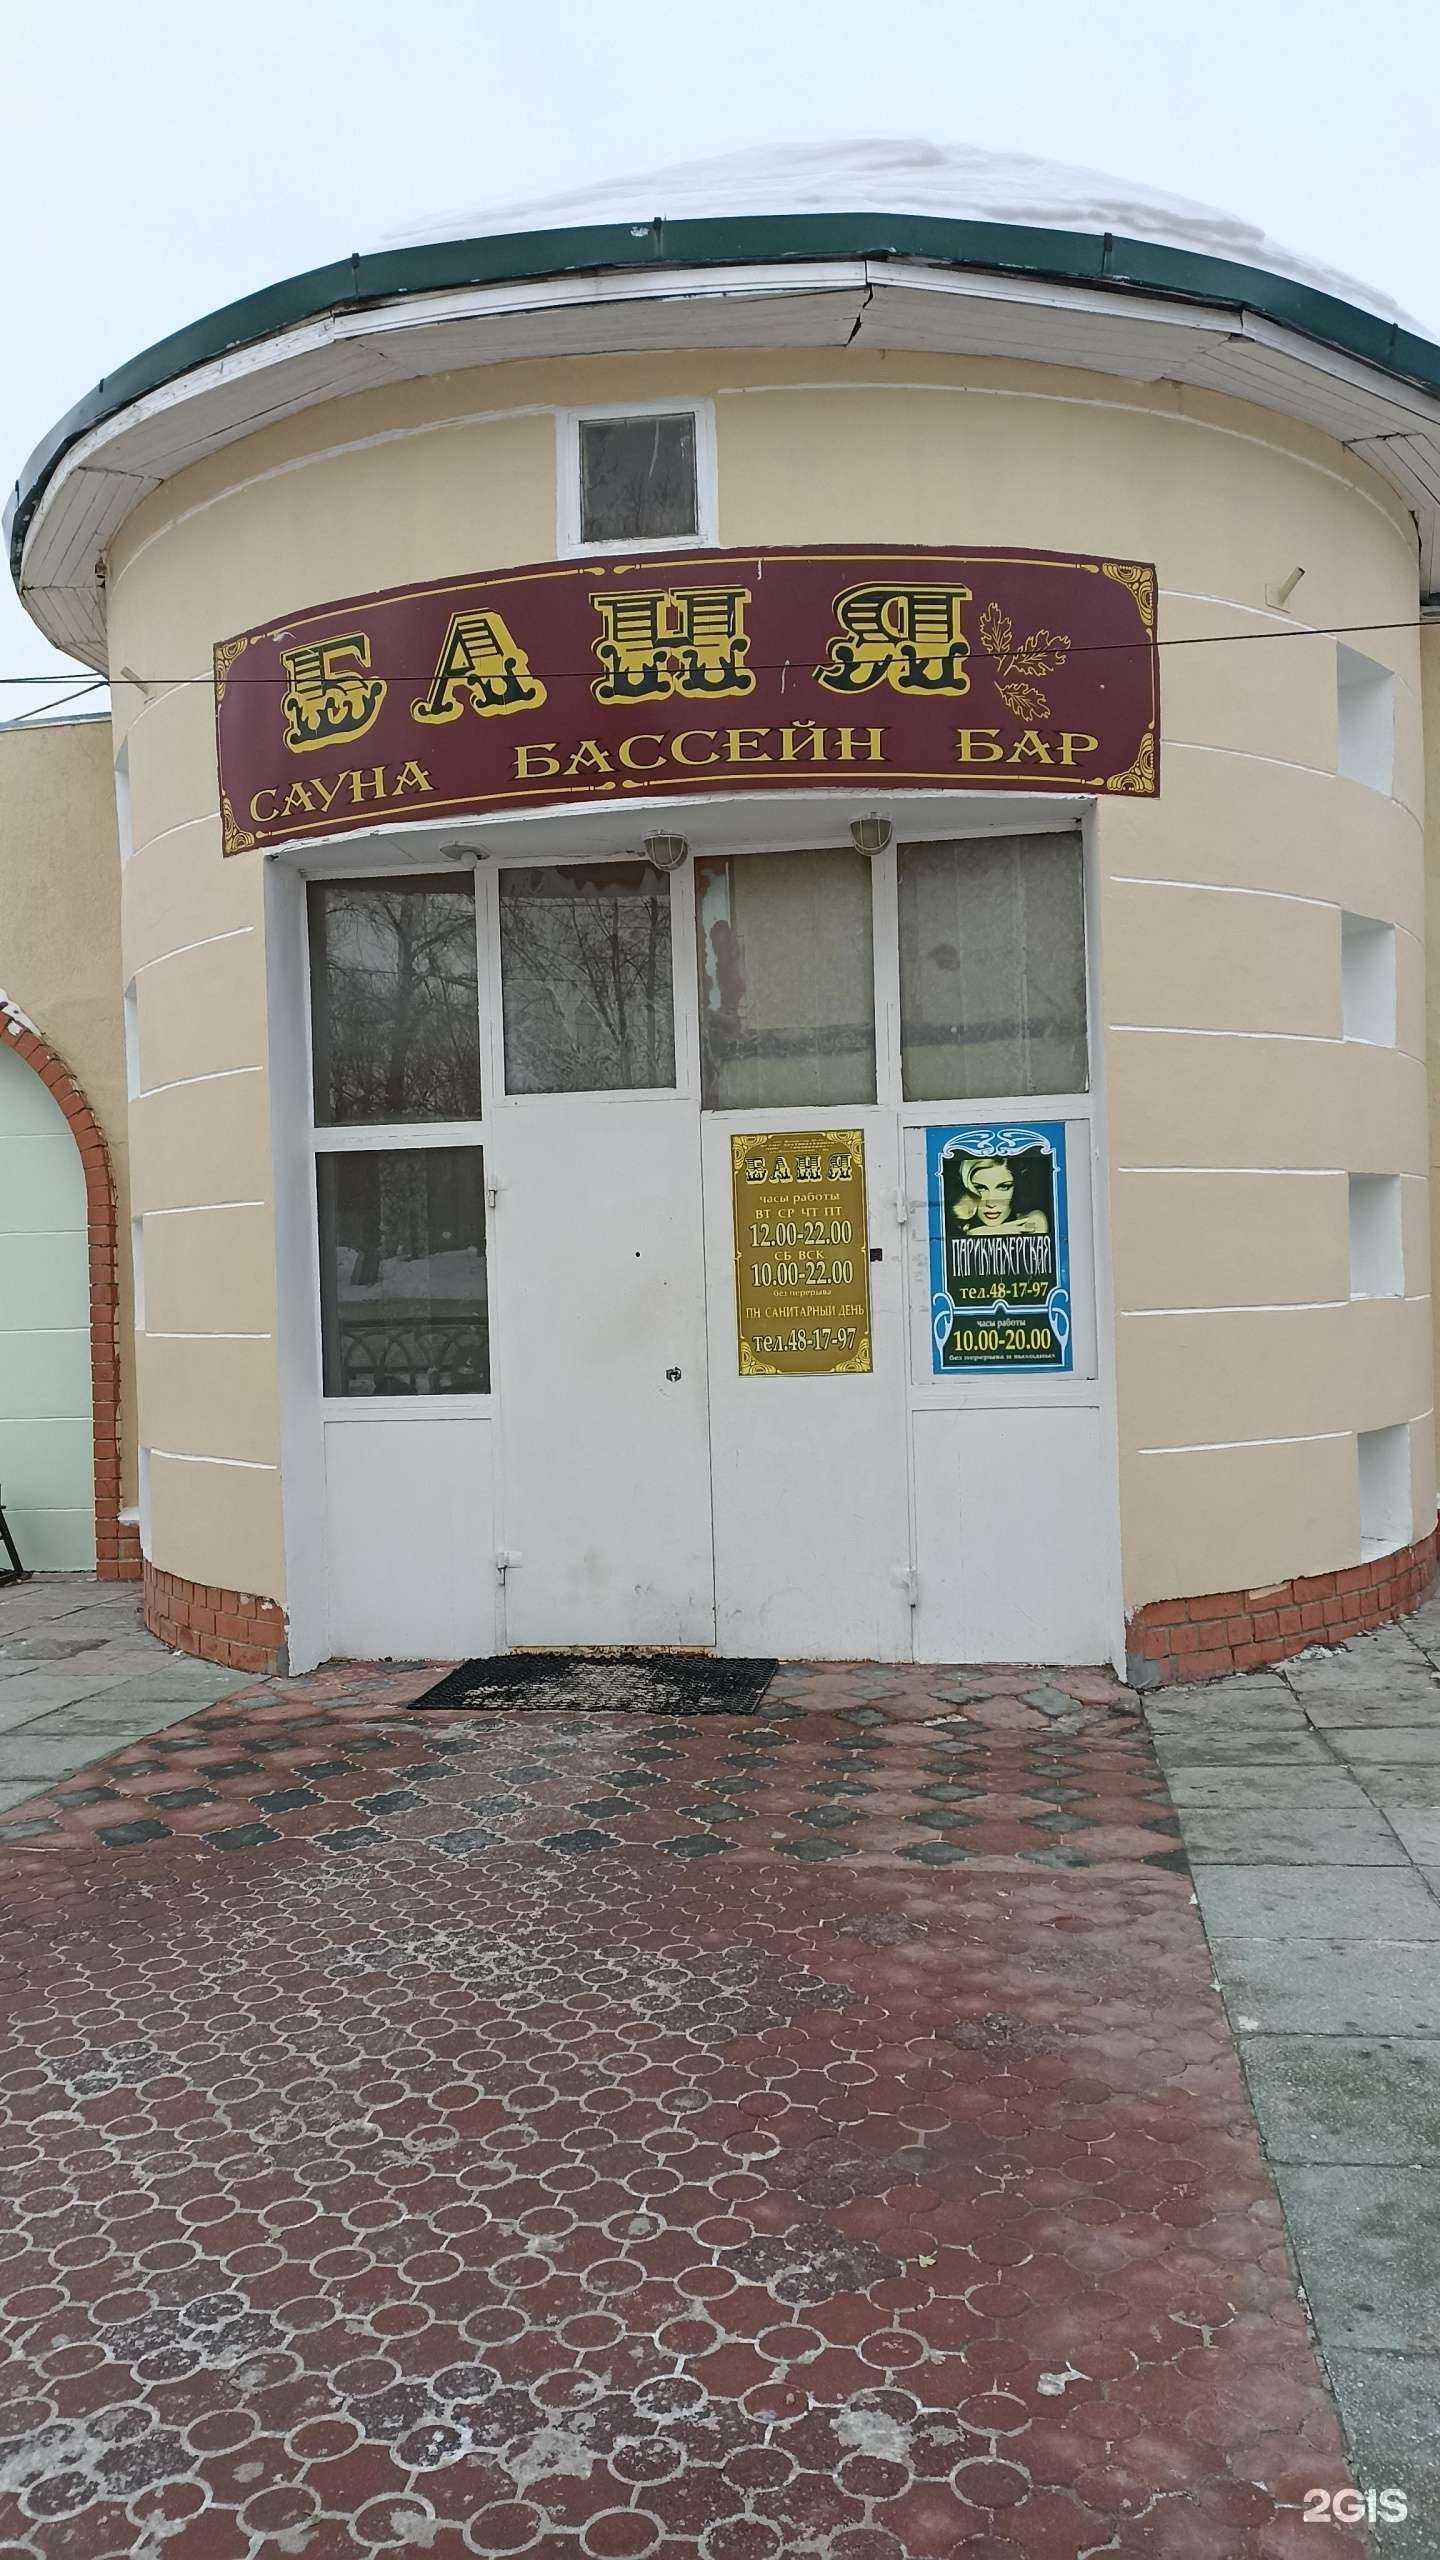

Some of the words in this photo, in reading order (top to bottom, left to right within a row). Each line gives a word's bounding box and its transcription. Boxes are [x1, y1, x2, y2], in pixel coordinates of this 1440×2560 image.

[280, 581, 972, 753] БАНЯ
[250, 760, 434, 822] САУНА
[512, 720, 886, 779] БАССЕЙН
[957, 728, 1099, 765] БАР
[745, 1152, 853, 1184] БАНЯ
[760, 1195, 789, 1204] часы
[793, 1192, 840, 1205] работы
[755, 1209, 770, 1219] ВТ
[778, 1208, 794, 1218] СР
[801, 1207, 819, 1217] ЧТ
[824, 1206, 842, 1216] ПТ
[749, 1220, 852, 1247] 12.00-22.00
[774, 1251, 792, 1261] СБ
[799, 1250, 824, 1260] ВСК
[951, 1236, 1052, 1277] ПАРИКМАХЕРСКАЯ
[751, 1260, 853, 1287] 10.00-22.00
[789, 1289, 832, 1298] перерыва
[960, 1282, 1049, 1299] тел.48-17-97
[746, 1307, 761, 1319] ПН
[838, 1303, 865, 1317] ДЕНЬ
[977, 1320, 996, 1328] часы
[997, 1318, 1026, 1328] работы
[752, 1327, 857, 1352] тел.48-17-97
[953, 1328, 1051, 1351] 10.00-20.00
